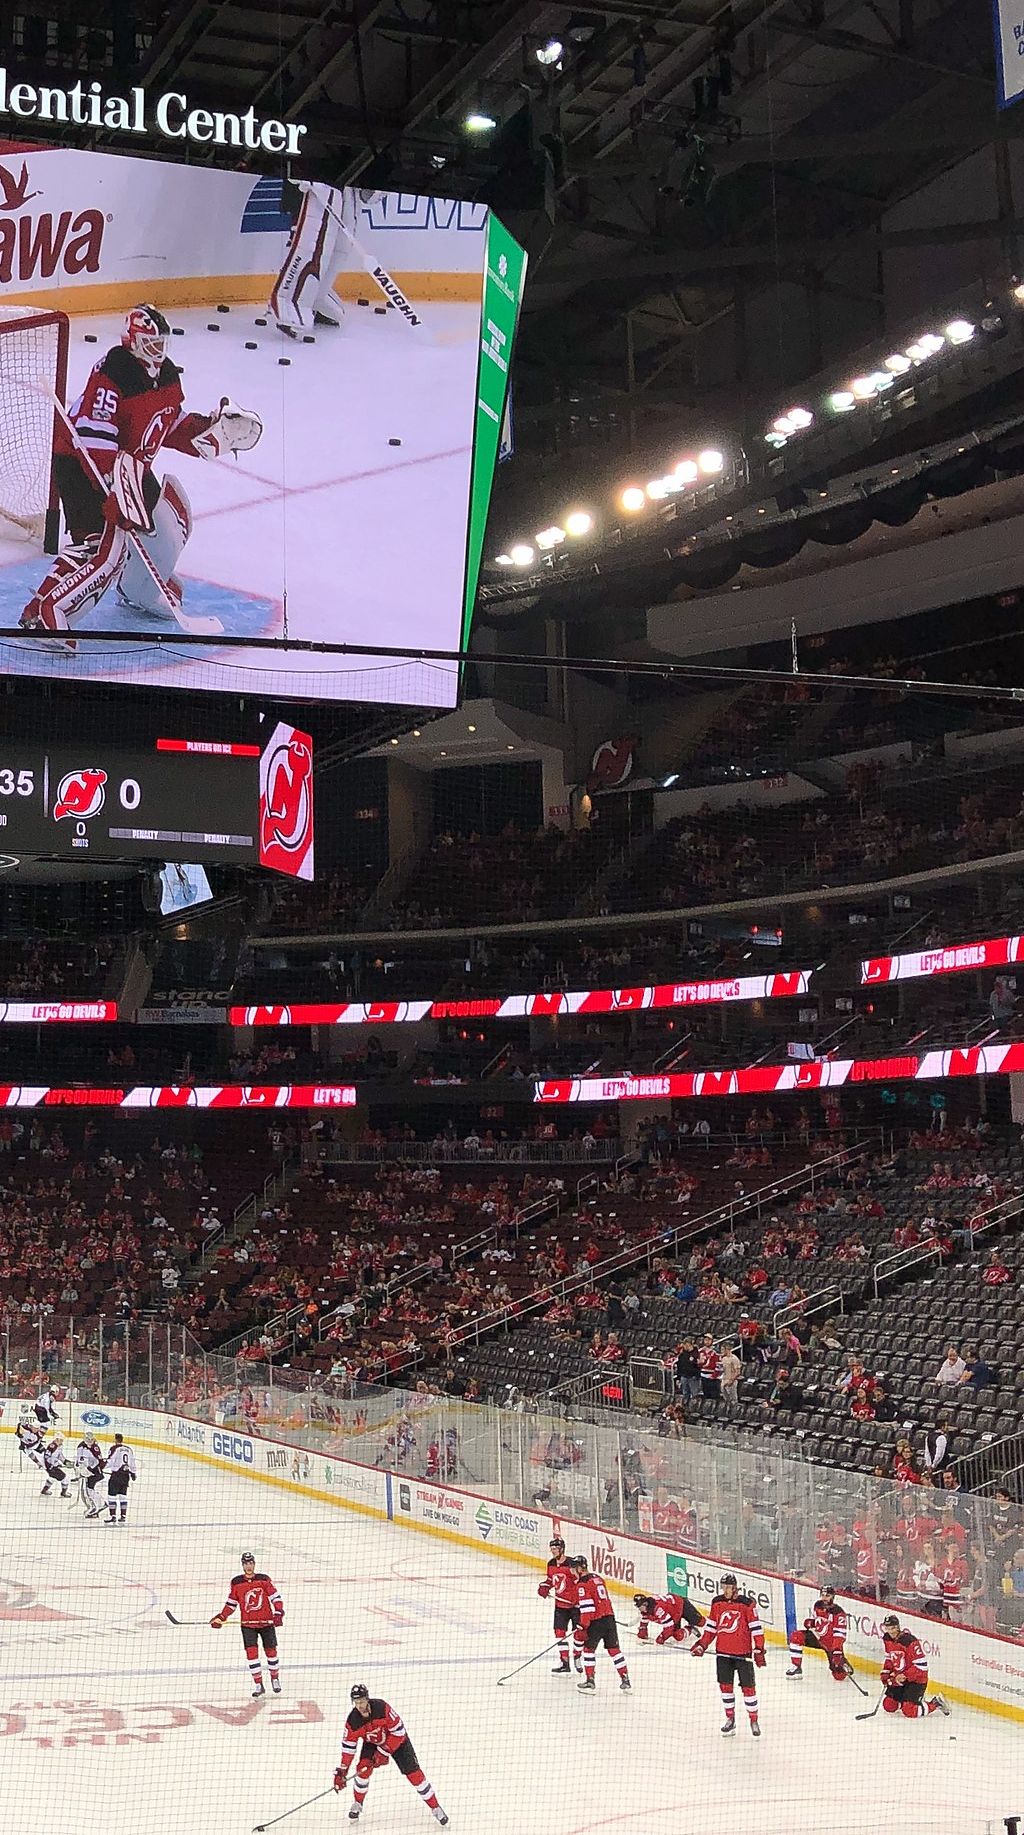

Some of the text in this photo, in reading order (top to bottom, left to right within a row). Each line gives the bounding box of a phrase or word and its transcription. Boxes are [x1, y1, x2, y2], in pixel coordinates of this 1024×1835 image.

[156, 92, 307, 154] Center
[283, 256, 302, 290] VAUGHN
[373, 266, 422, 327] VAUGHN
[93, 387, 119, 413] 35
[52, 563, 95, 600] VAUGHN
[186, 741, 212, 752] PLAYERS
[223, 743, 232, 754] ICE
[119, 779, 141, 809] 0
[76, 822, 86, 836] 0
[132, 829, 159, 840] PENALTY
[204, 833, 231, 844] PENALTY
[72, 839, 89, 848] SHOTS
[921, 945, 985, 971] LET'S GO DEVILS
[673, 981, 739, 1002] LET'S GO DEVILS
[32, 1005, 106, 1019] LET'S GO DEVILS
[314, 1088, 355, 1105] LET'S GO
[603, 1078, 670, 1097] LET'S GO DEVILS
[213, 1433, 253, 1463] GEICO
[416, 1490, 437, 1504] STREAM
[423, 1507, 433, 1518] LIVE
[495, 1511, 539, 1533] EAST COAST
[591, 1545, 635, 1583] Wawa
